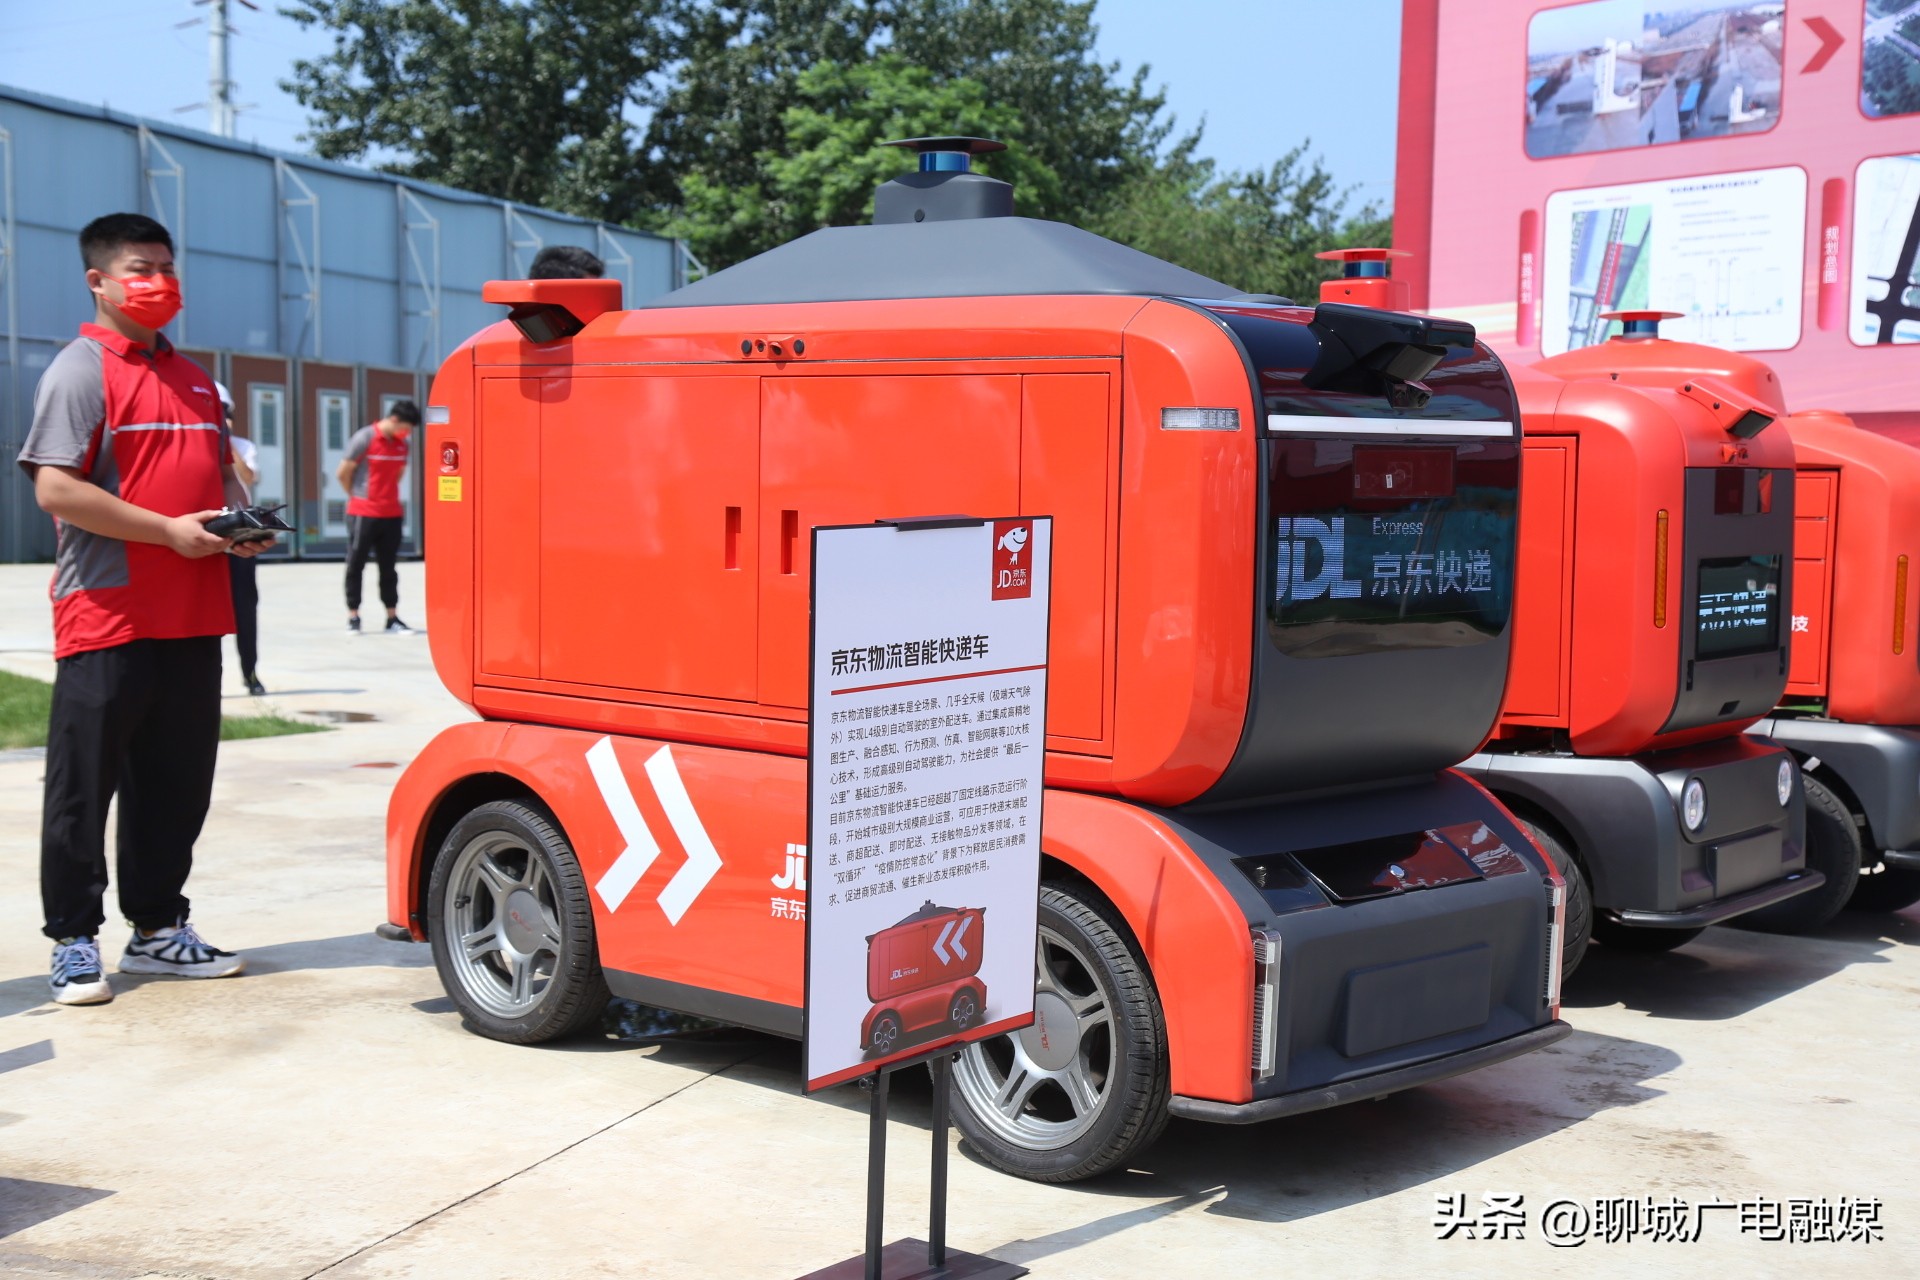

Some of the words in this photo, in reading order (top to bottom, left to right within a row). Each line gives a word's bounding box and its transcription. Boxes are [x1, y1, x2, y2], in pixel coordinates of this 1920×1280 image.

[1373, 517, 1423, 540] Express
[1276, 517, 1362, 600] JDL
[1372, 550, 1491, 596] 京东快递
[831, 634, 989, 676] 京东物流智能快递车
